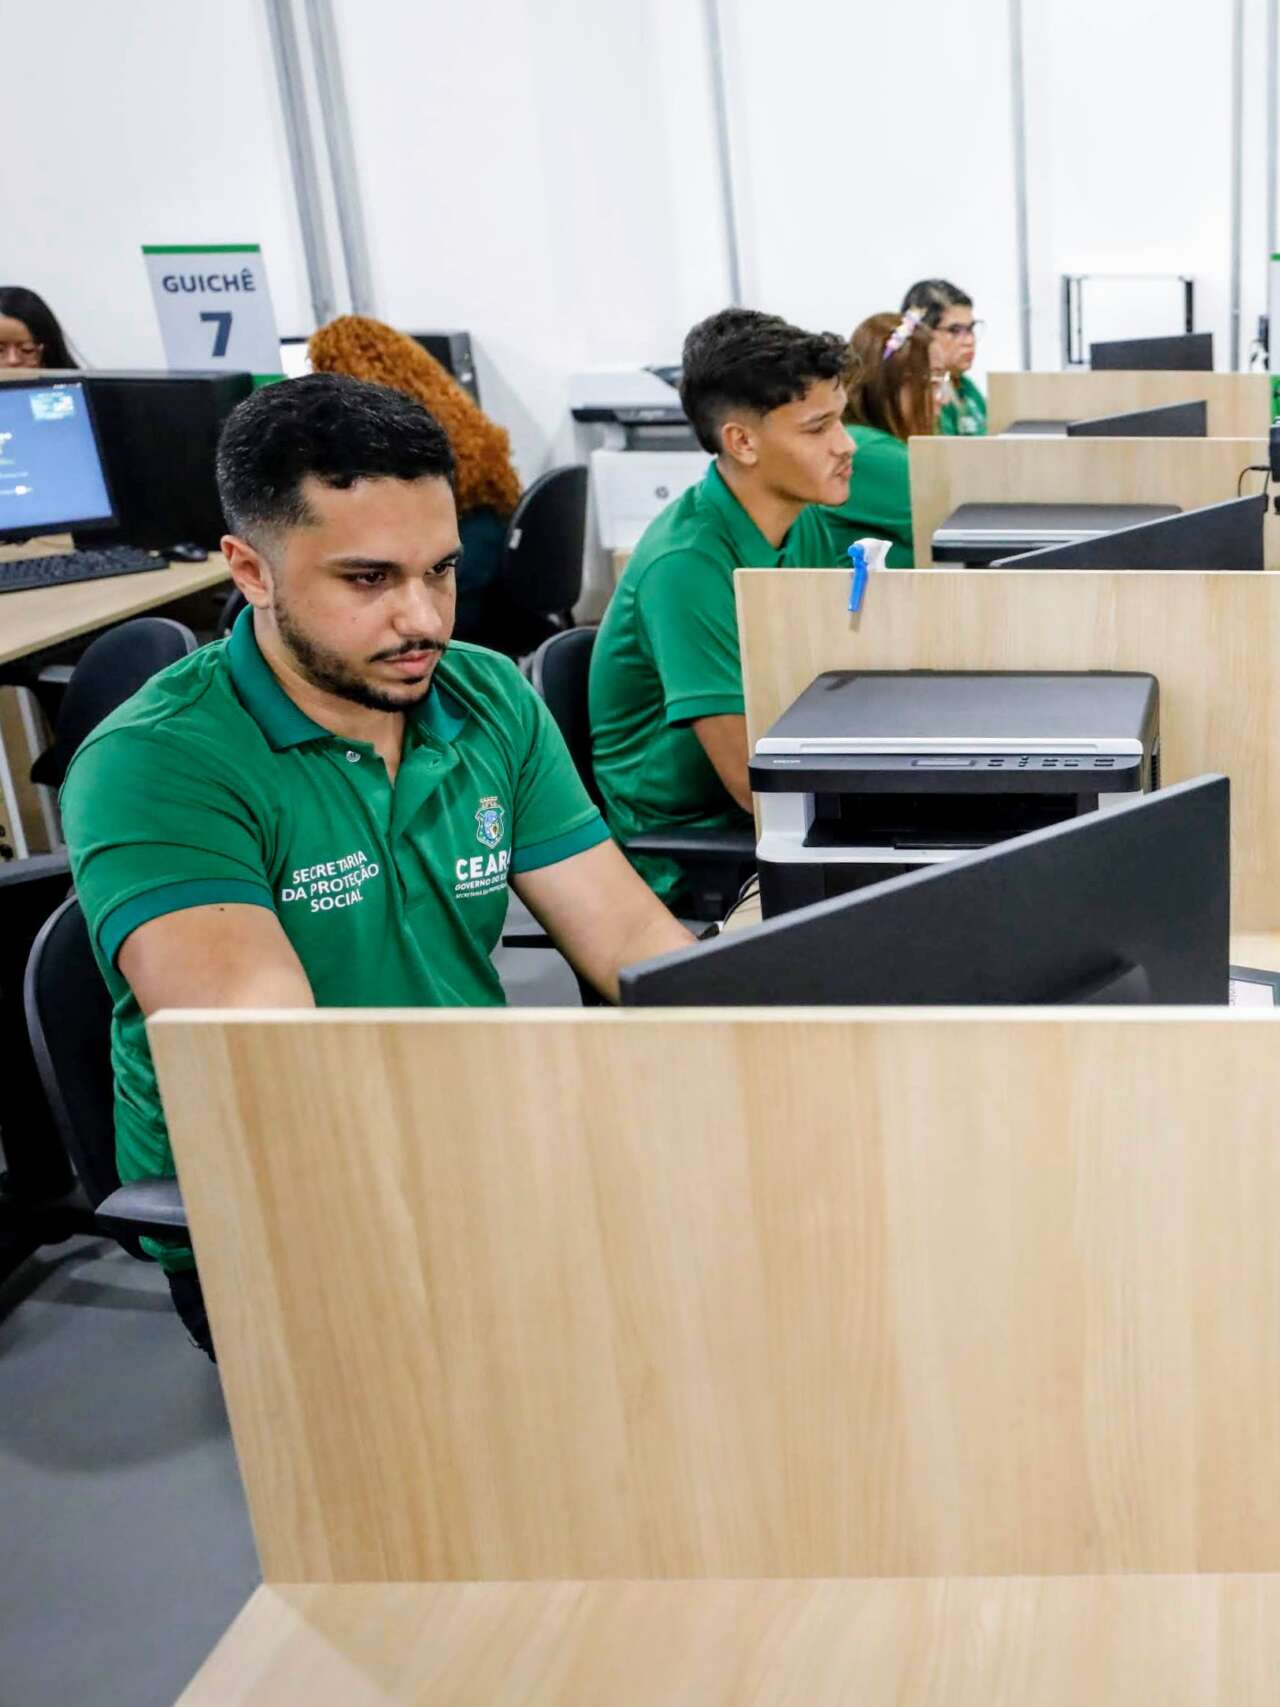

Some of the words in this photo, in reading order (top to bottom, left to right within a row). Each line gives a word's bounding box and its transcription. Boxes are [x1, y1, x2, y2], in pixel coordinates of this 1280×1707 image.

[162, 267, 256, 292] GUICHÊ
[200, 311, 232, 357] 7
[281, 887, 307, 902] DA
[310, 863, 379, 897] PROTEÇÃO
[292, 850, 367, 884] SECRETARIA
[310, 888, 363, 913] SOCIAL
